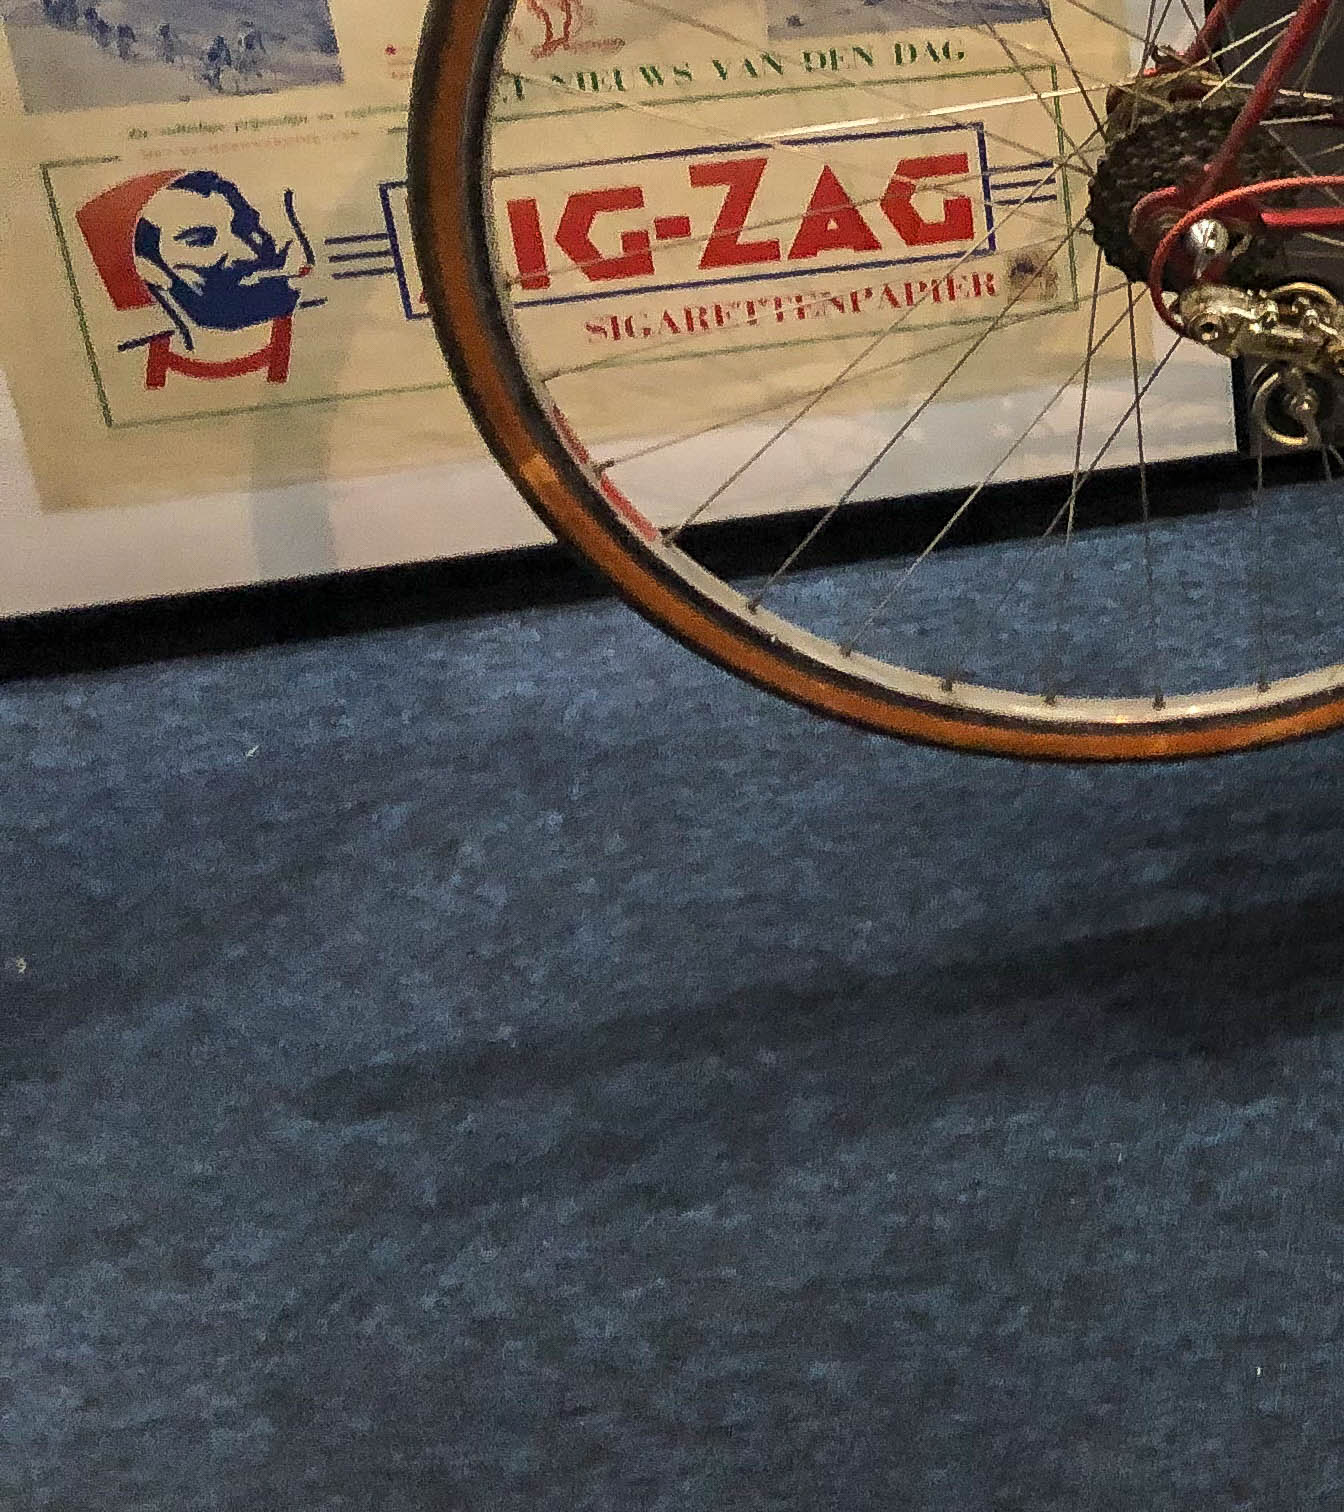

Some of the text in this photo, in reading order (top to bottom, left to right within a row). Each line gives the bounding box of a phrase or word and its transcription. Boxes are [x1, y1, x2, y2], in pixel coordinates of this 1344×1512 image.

[551, 61, 693, 94] NIEUWS
[711, 51, 785, 83] VAN
[801, 45, 876, 75] DEN
[894, 37, 967, 66] DAG
[505, 152, 976, 291] IG-ZAG
[584, 269, 998, 344] SIGARETTENPAPIER
